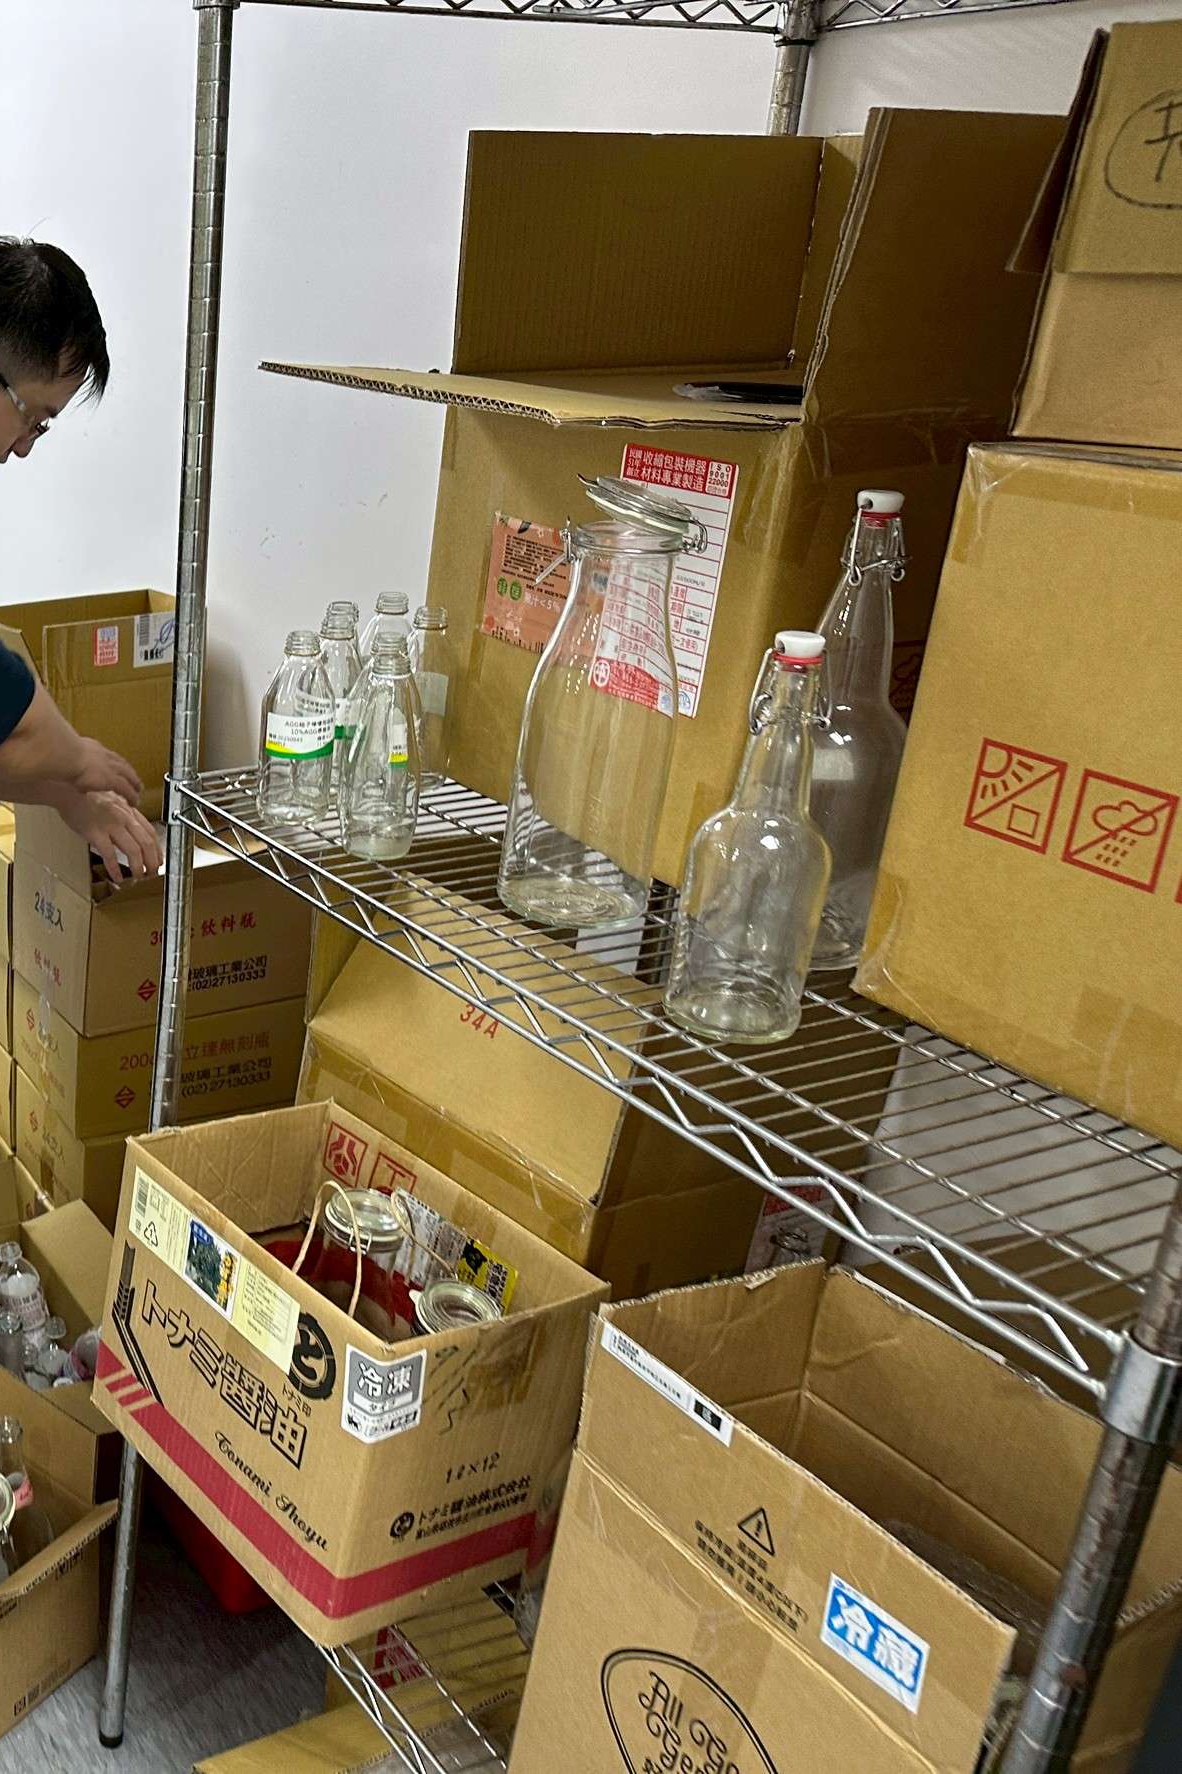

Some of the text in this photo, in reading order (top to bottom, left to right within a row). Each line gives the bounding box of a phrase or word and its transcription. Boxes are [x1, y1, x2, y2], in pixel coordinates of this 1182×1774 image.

[34, 890, 64, 932] 24支入
[201, 911, 257, 937] 飲料瓶
[188, 955, 267, 981] 玻璃工業公司
[460, 1003, 500, 1039] 34A
[358, 1362, 414, 1398] 冷凍
[215, 1431, 328, 1551] Tonami Shoyu
[830, 1593, 920, 1690] 冷藏
[638, 1671, 683, 1728] All
